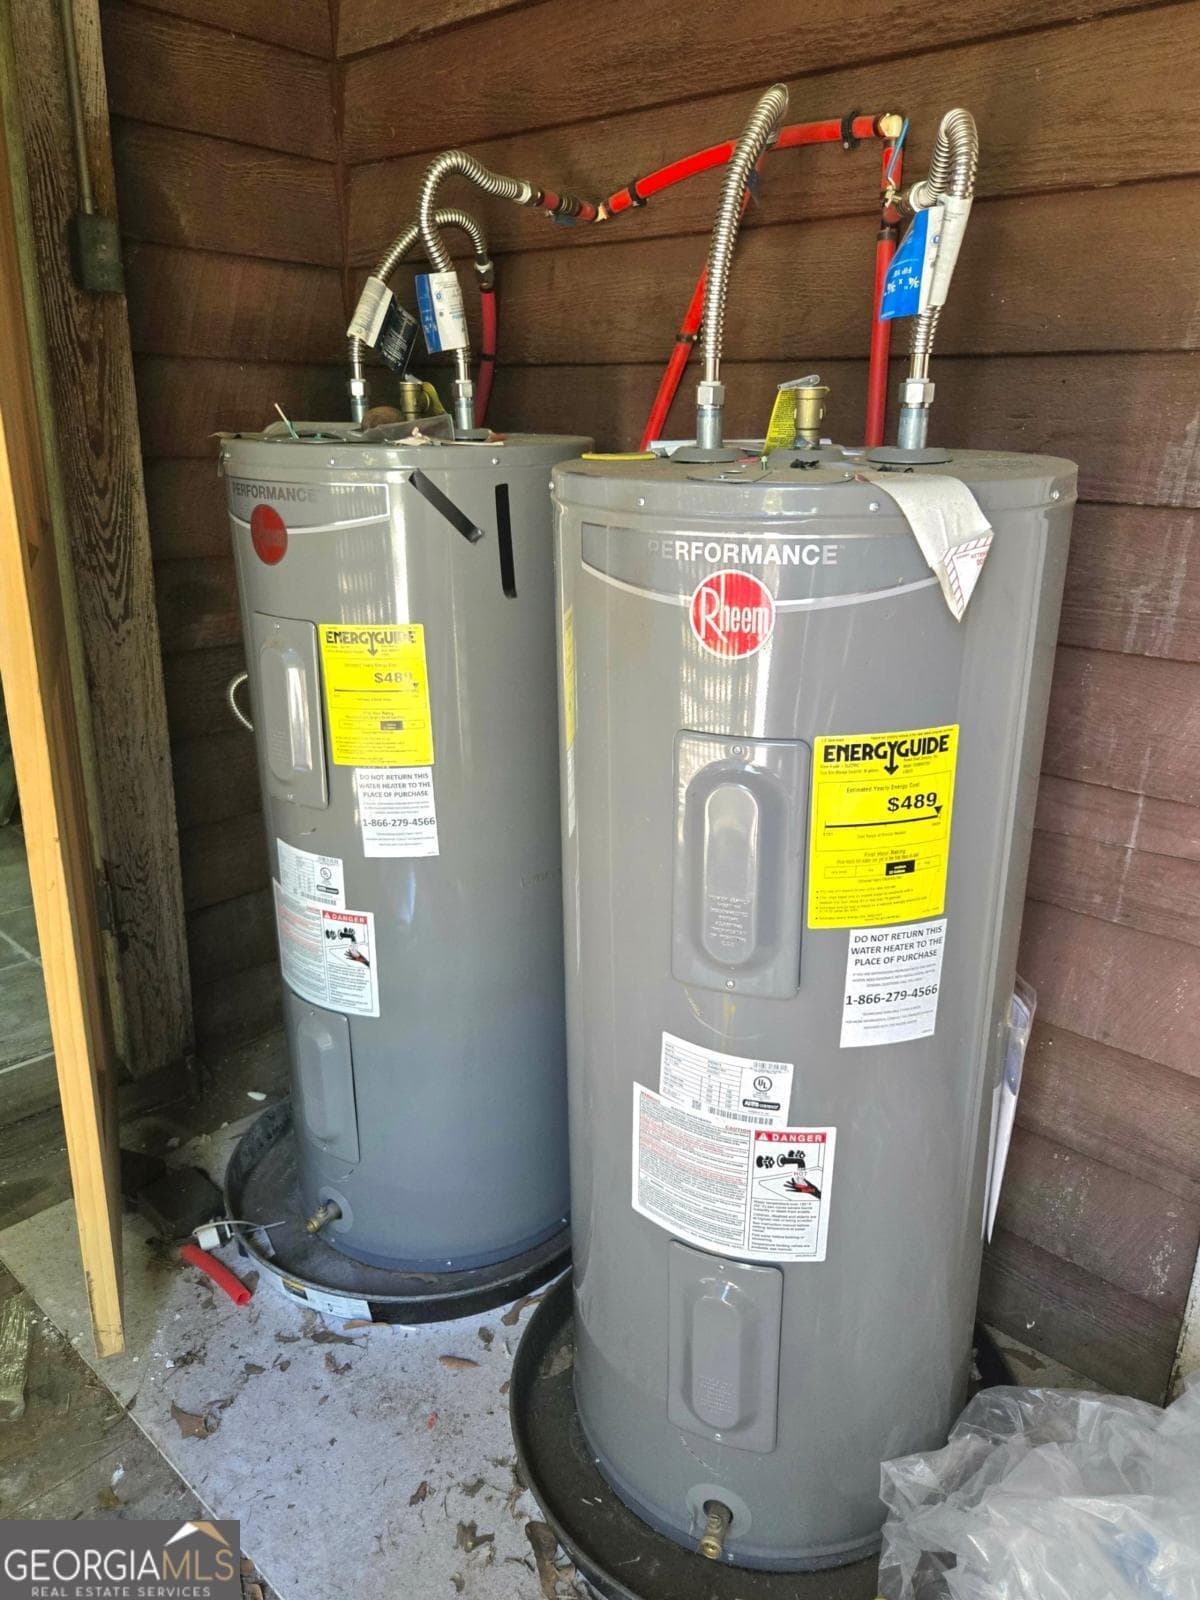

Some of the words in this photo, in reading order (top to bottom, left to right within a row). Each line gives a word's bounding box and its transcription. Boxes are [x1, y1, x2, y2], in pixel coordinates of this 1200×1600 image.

[232, 481, 319, 503] PERFORMANCE
[648, 540, 838, 566] PERFORMANCE
[700, 572, 769, 643] Rheem
[823, 734, 950, 763] ENERGYGUIDE
[394, 790, 429, 798] PURCHASE
[887, 792, 938, 813] $489
[363, 816, 436, 827] 1-866-279-4566
[332, 914, 365, 923] DANGER
[854, 935, 869, 943] DO
[870, 933, 889, 942] NOT
[891, 929, 924, 941] RETURN
[925, 926, 943, 935] THIS
[851, 946, 881, 955] WATER
[883, 942, 915, 953] HEATER
[916, 940, 927, 948] TO
[929, 937, 943, 945] THE
[854, 957, 881, 967] PLACE
[883, 956, 895, 964] OF
[896, 949, 938, 962] PURCHASE
[846, 984, 938, 1005] 1-866-279-4566
[772, 1133, 823, 1143] DANGER
